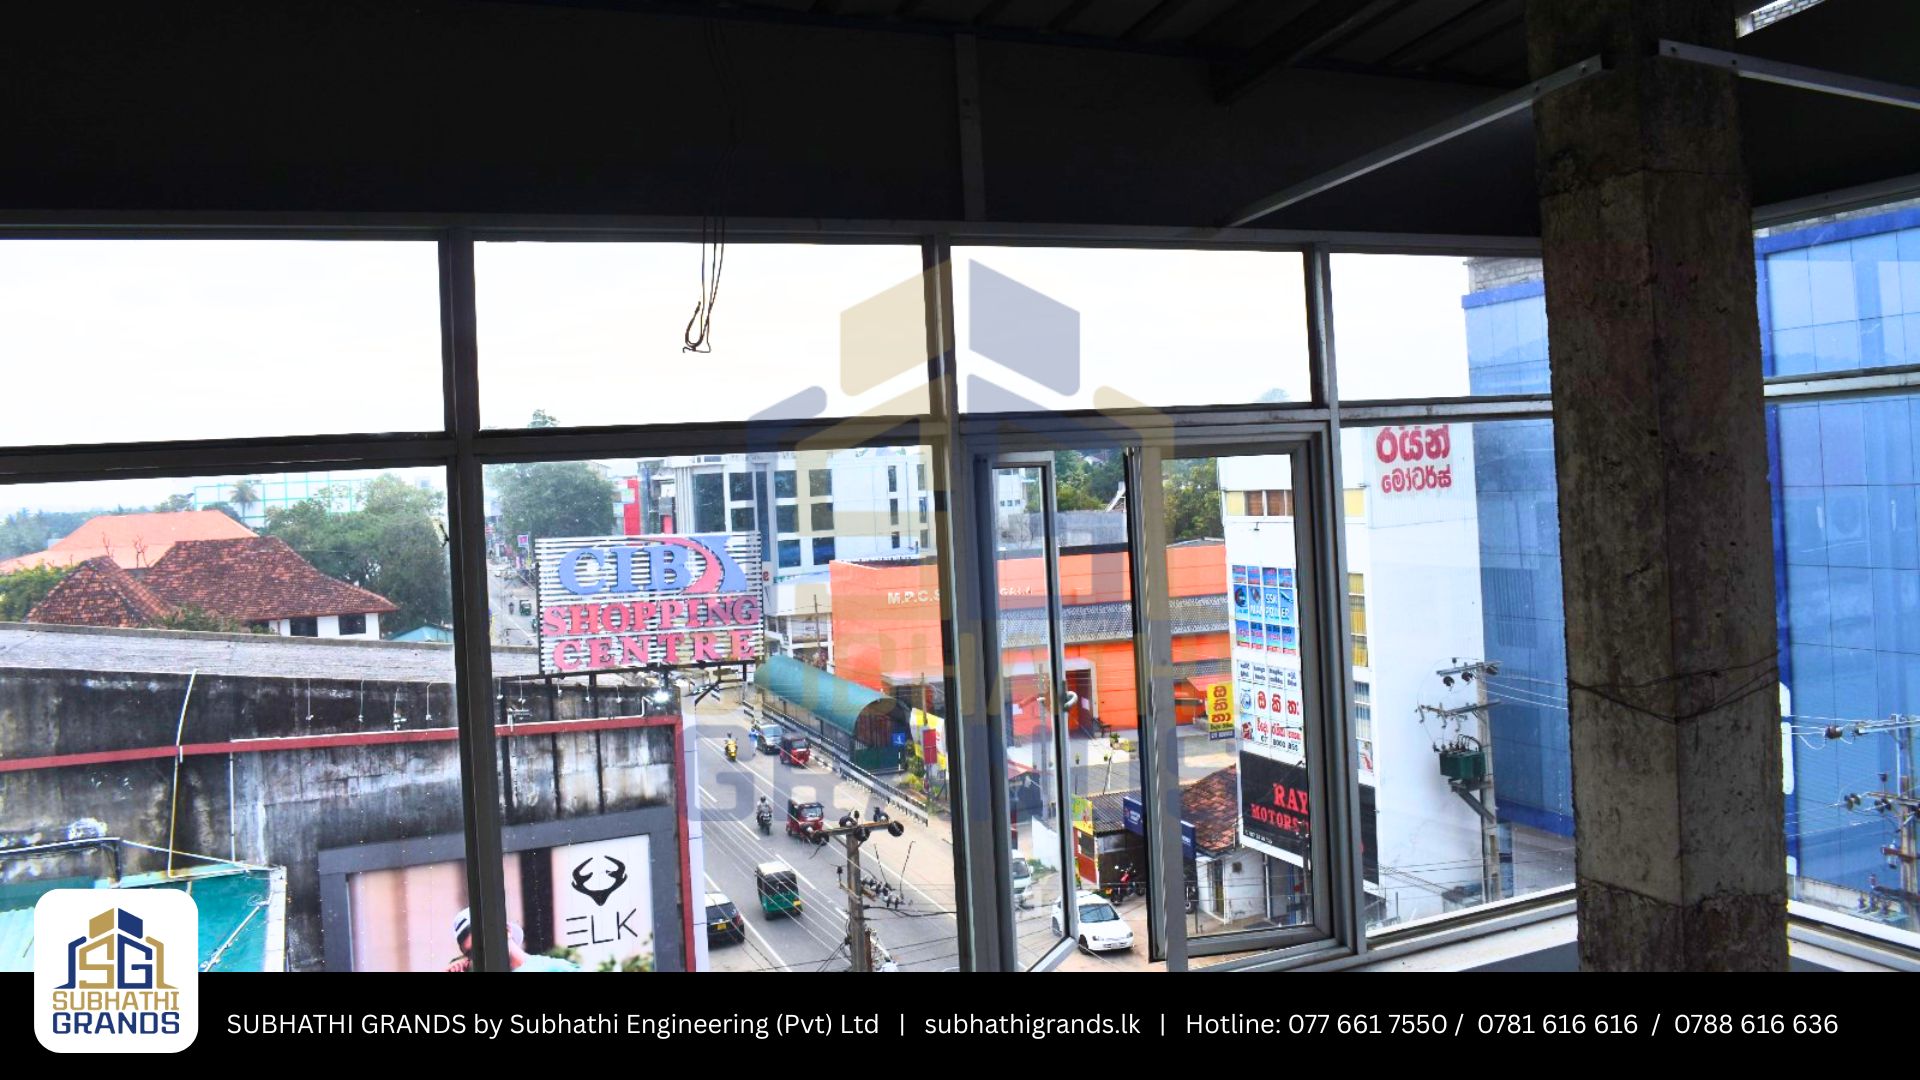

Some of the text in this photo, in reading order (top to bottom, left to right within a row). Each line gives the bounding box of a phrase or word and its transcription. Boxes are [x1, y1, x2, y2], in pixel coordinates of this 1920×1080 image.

[558, 545, 693, 595] CIB
[543, 595, 761, 636] SHOPPING
[553, 629, 755, 671] CENTRE
[565, 907, 639, 949] ELK
